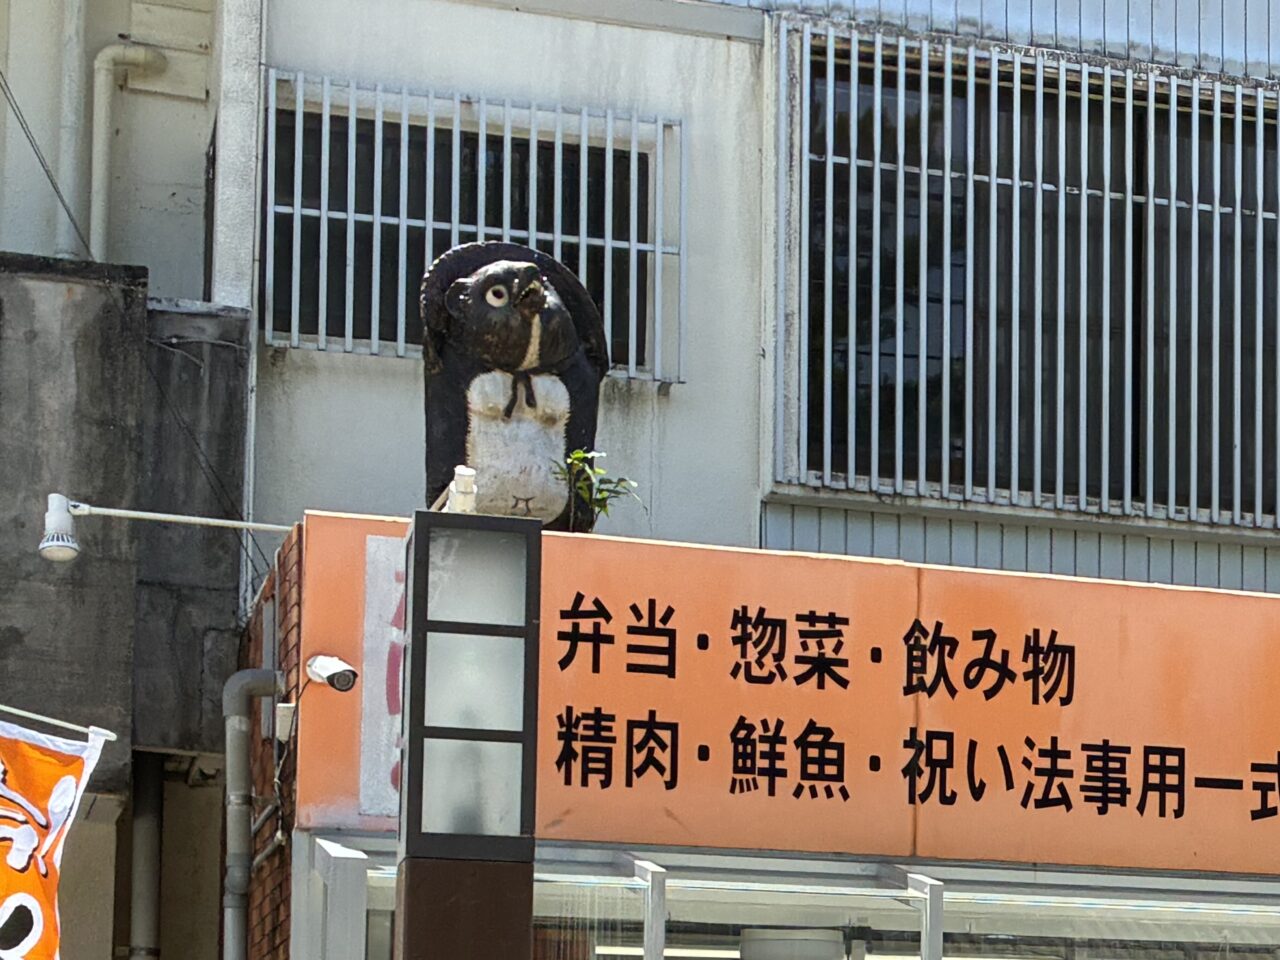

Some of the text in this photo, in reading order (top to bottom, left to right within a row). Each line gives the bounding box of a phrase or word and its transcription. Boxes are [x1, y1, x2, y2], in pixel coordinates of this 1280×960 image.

[556, 590, 1076, 707] 弁当・惣菜・飲み物
